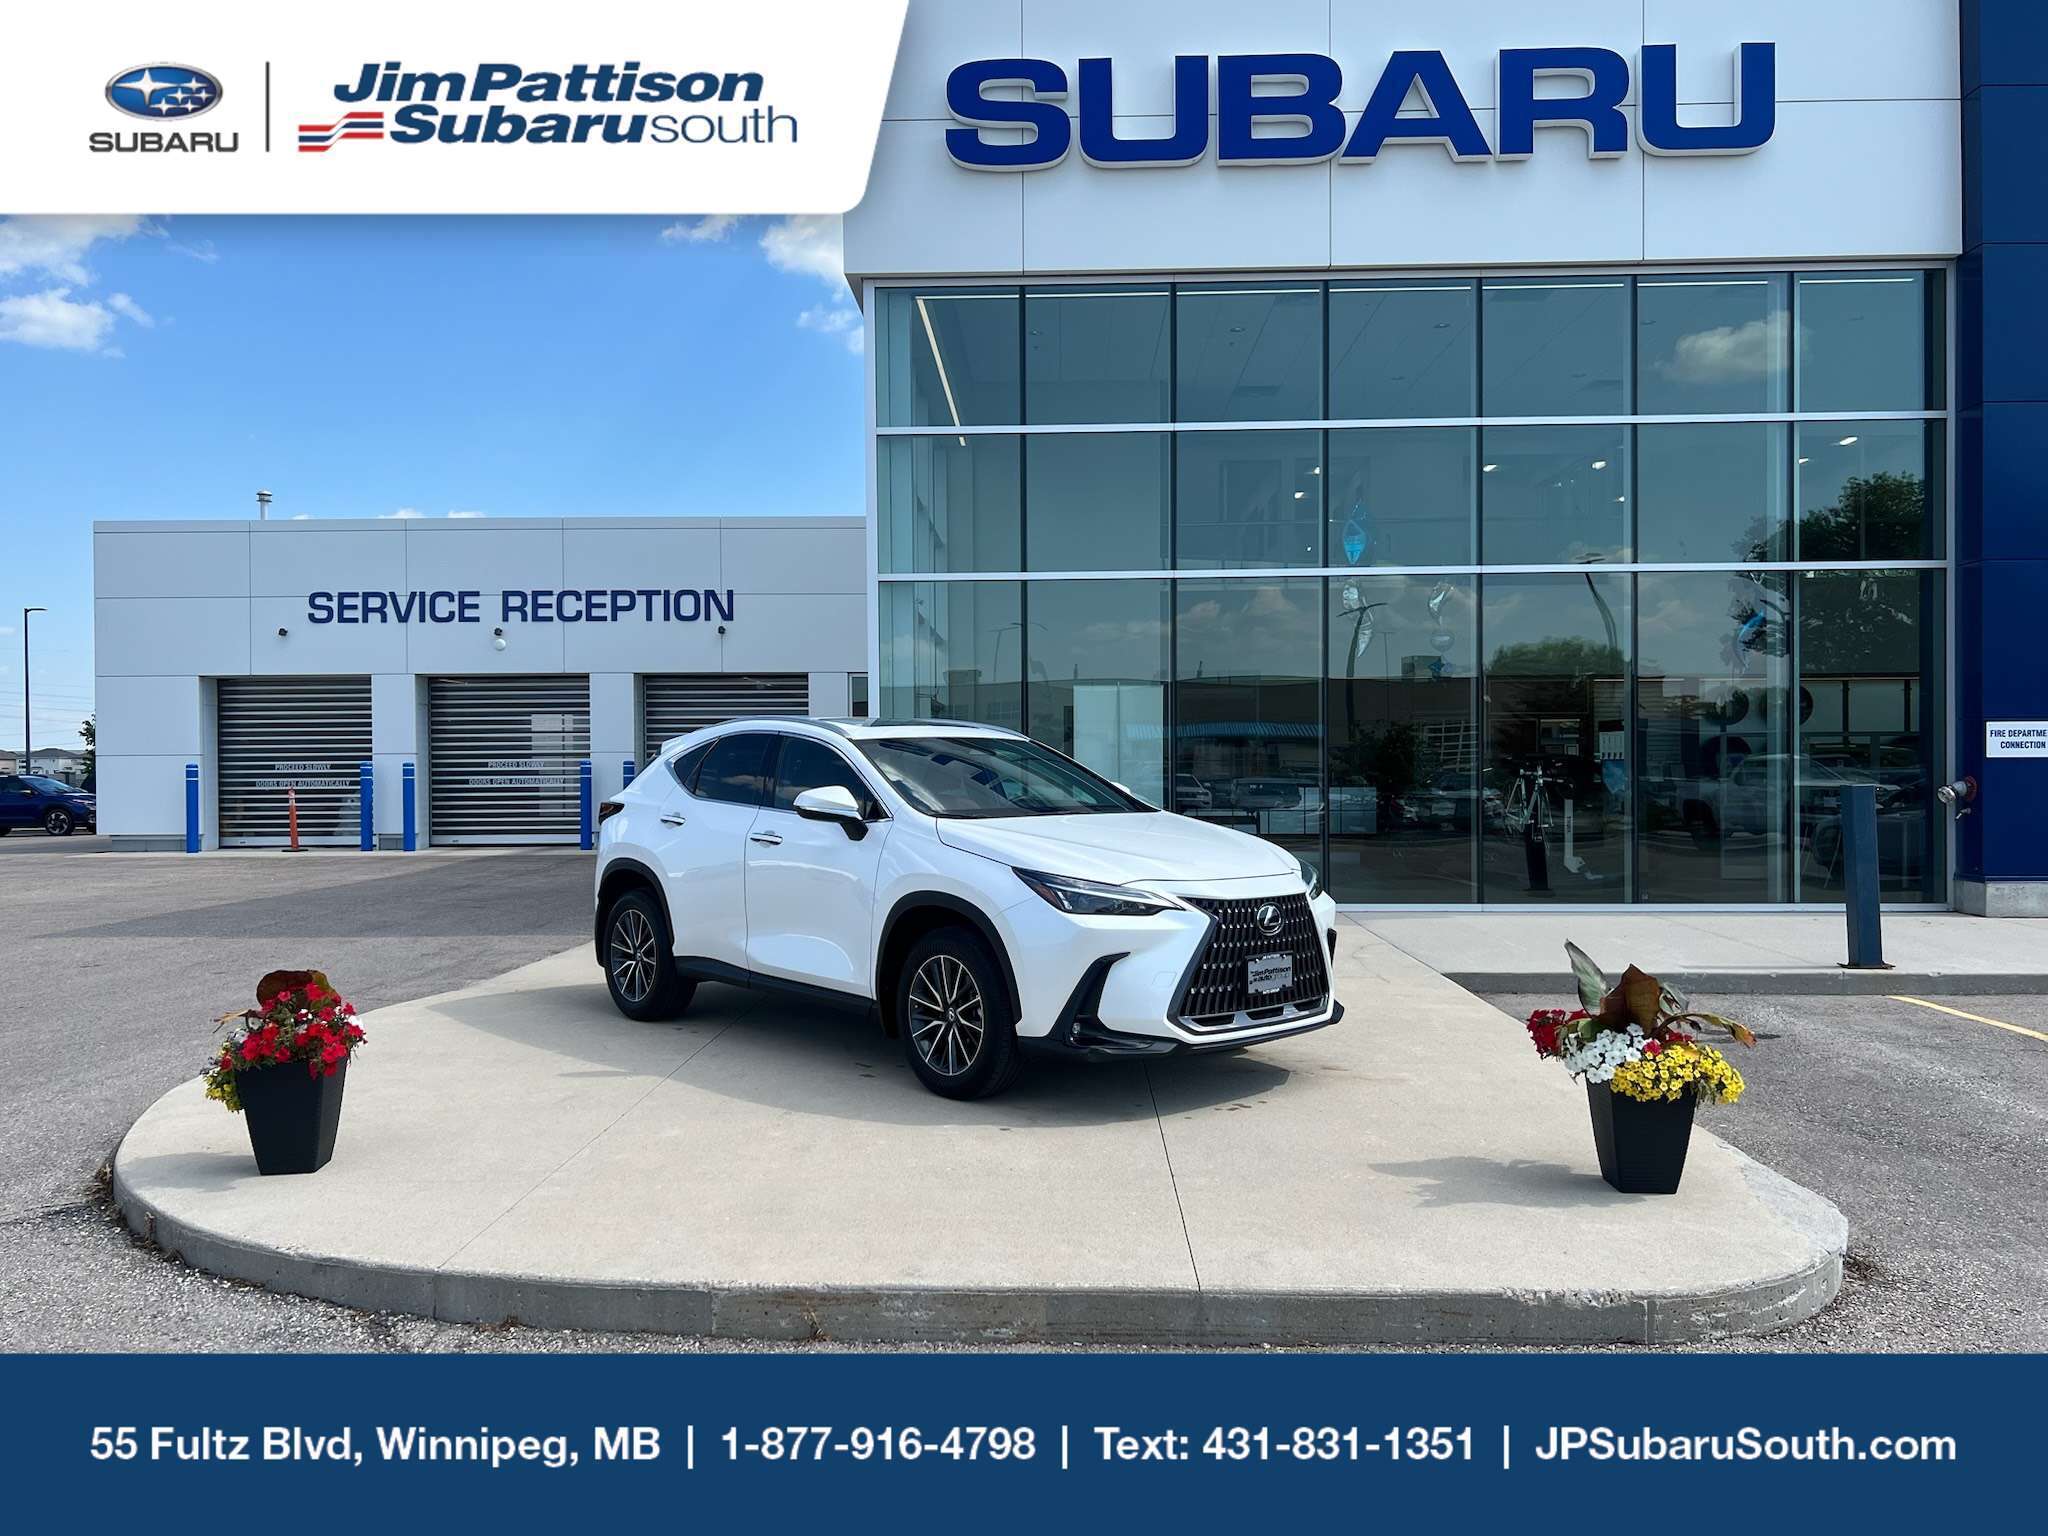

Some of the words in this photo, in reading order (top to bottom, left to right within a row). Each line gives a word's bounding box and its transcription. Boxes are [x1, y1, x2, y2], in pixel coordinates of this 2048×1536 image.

[945, 42, 1776, 168] SUBARU
[308, 592, 480, 624] SERVICE
[502, 589, 735, 622] RECEPTION
[1990, 729, 2007, 738] FIRE
[2000, 741, 2046, 749] CONNECTION
[275, 763, 303, 771] PROCEED
[304, 763, 332, 771] SLOWLY
[488, 760, 517, 768] PROCEED
[518, 760, 545, 768] SLOWLY
[256, 779, 278, 788] DOORS
[278, 779, 297, 788] OPEN
[297, 779, 350, 788] AUTOMATICALLY
[469, 778, 491, 786] DOORS
[491, 778, 510, 786] OPEN
[511, 777, 565, 786] AUTOMATICALLY
